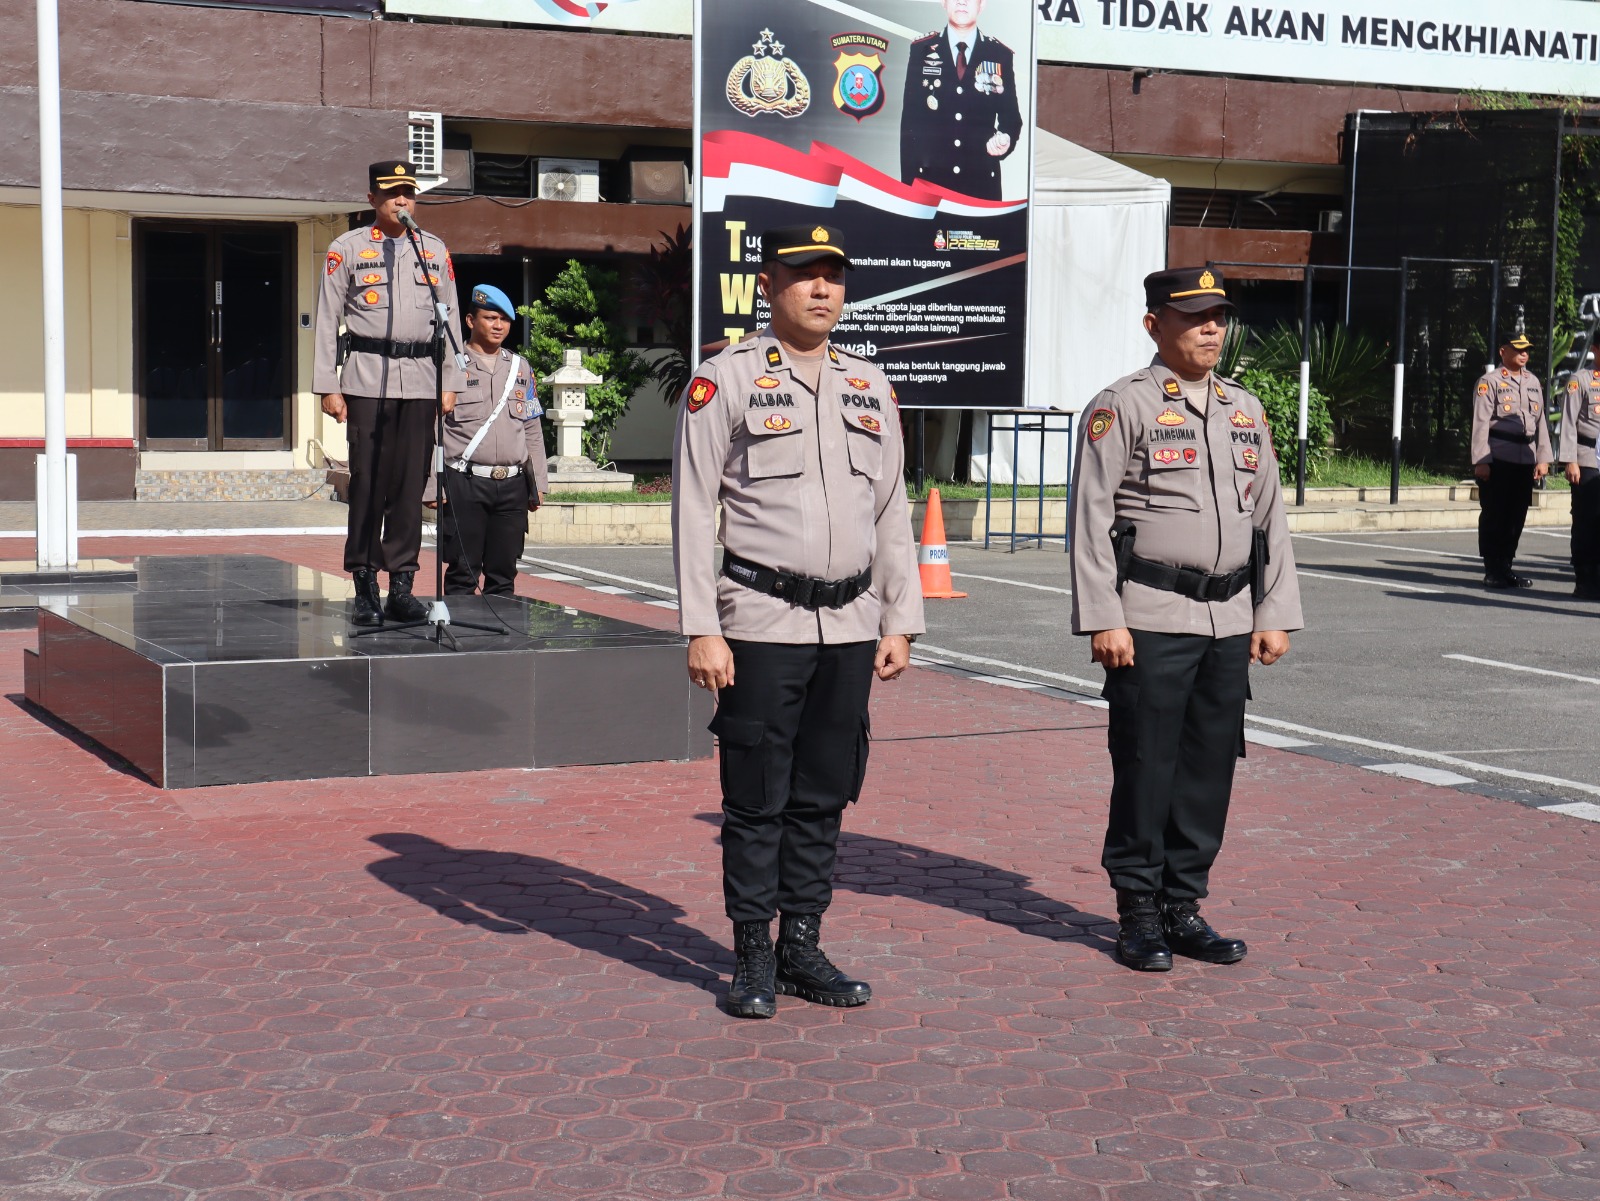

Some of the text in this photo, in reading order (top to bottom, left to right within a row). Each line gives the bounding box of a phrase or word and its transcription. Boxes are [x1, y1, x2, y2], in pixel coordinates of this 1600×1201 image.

[1096, 0, 1208, 33] TIDAK
[1223, 5, 1324, 42] AKAN
[1341, 15, 1597, 61] MENGKHIANATI
[832, 35, 887, 50] SUMATERA UTARA
[949, 239, 999, 248] PRESISI
[414, 262, 440, 272] PLRI
[890, 258, 911, 267] akan
[913, 258, 951, 269] tugasnya
[850, 302, 875, 312] tugas,
[876, 303, 908, 313] anggota
[909, 303, 927, 313] juga
[928, 303, 963, 312] diberikan
[964, 305, 1006, 314] wewenang;
[852, 312, 885, 321] Reskrim
[886, 312, 923, 322] diberikan
[923, 315, 964, 324] wewenang
[965, 314, 1005, 323] melakukan
[864, 323, 878, 331] dan
[880, 325, 904, 334] upaya
[906, 324, 928, 333] paksa
[930, 324, 960, 334] lainnya)
[886, 361, 910, 370] maka
[911, 361, 941, 370] bentuk
[942, 362, 980, 372] tanggung
[981, 362, 1006, 372] jawab
[909, 373, 947, 383] tugasnya
[749, 393, 795, 409] ALBAR
[841, 394, 881, 411] POLRI
